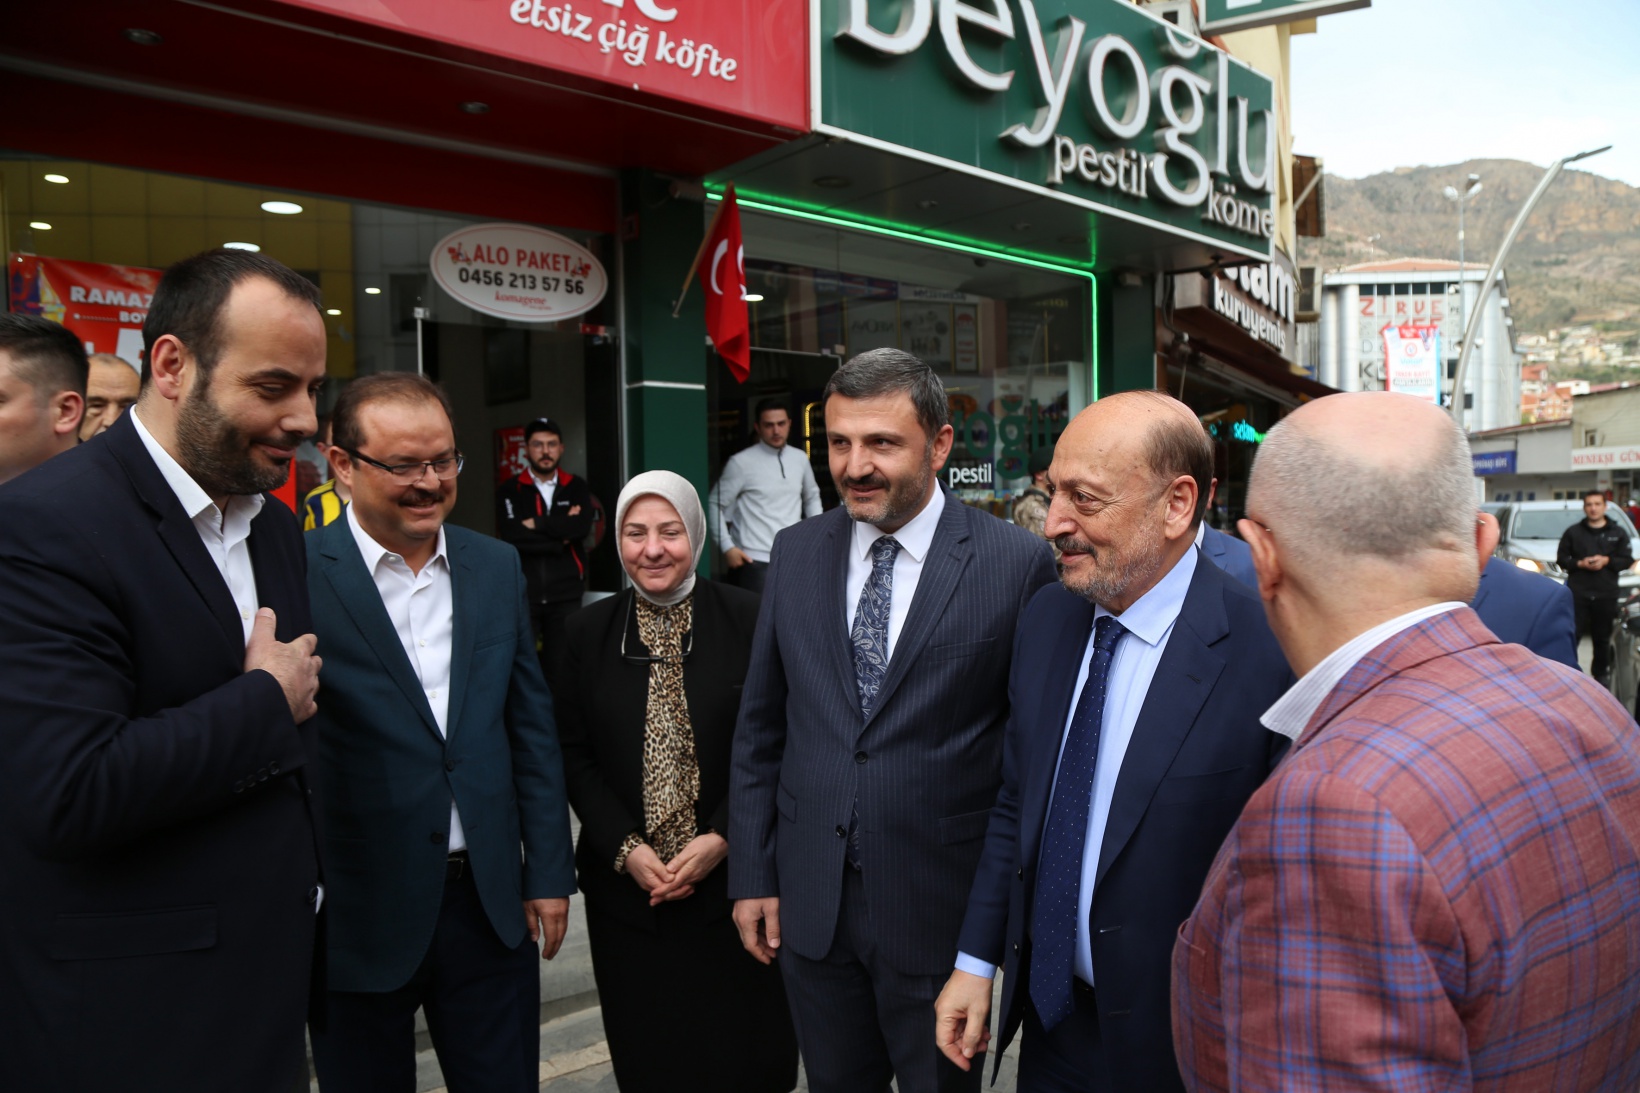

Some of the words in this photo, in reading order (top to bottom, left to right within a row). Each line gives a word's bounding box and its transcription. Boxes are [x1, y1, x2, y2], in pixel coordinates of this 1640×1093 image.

[509, 0, 593, 42] etsiz
[598, 19, 649, 67] çiğ
[655, 31, 737, 81] köfte
[1049, 134, 1147, 198] pestil
[1207, 180, 1275, 239] köme
[459, 266, 504, 287] 0456
[509, 272, 537, 290] 213
[542, 276, 560, 292] 57
[564, 279, 584, 295] 56
[473, 243, 509, 266] ALO
[516, 247, 572, 273] PAKET
[1214, 276, 1286, 354] kuruyemiş
[949, 463, 993, 488] pestil
